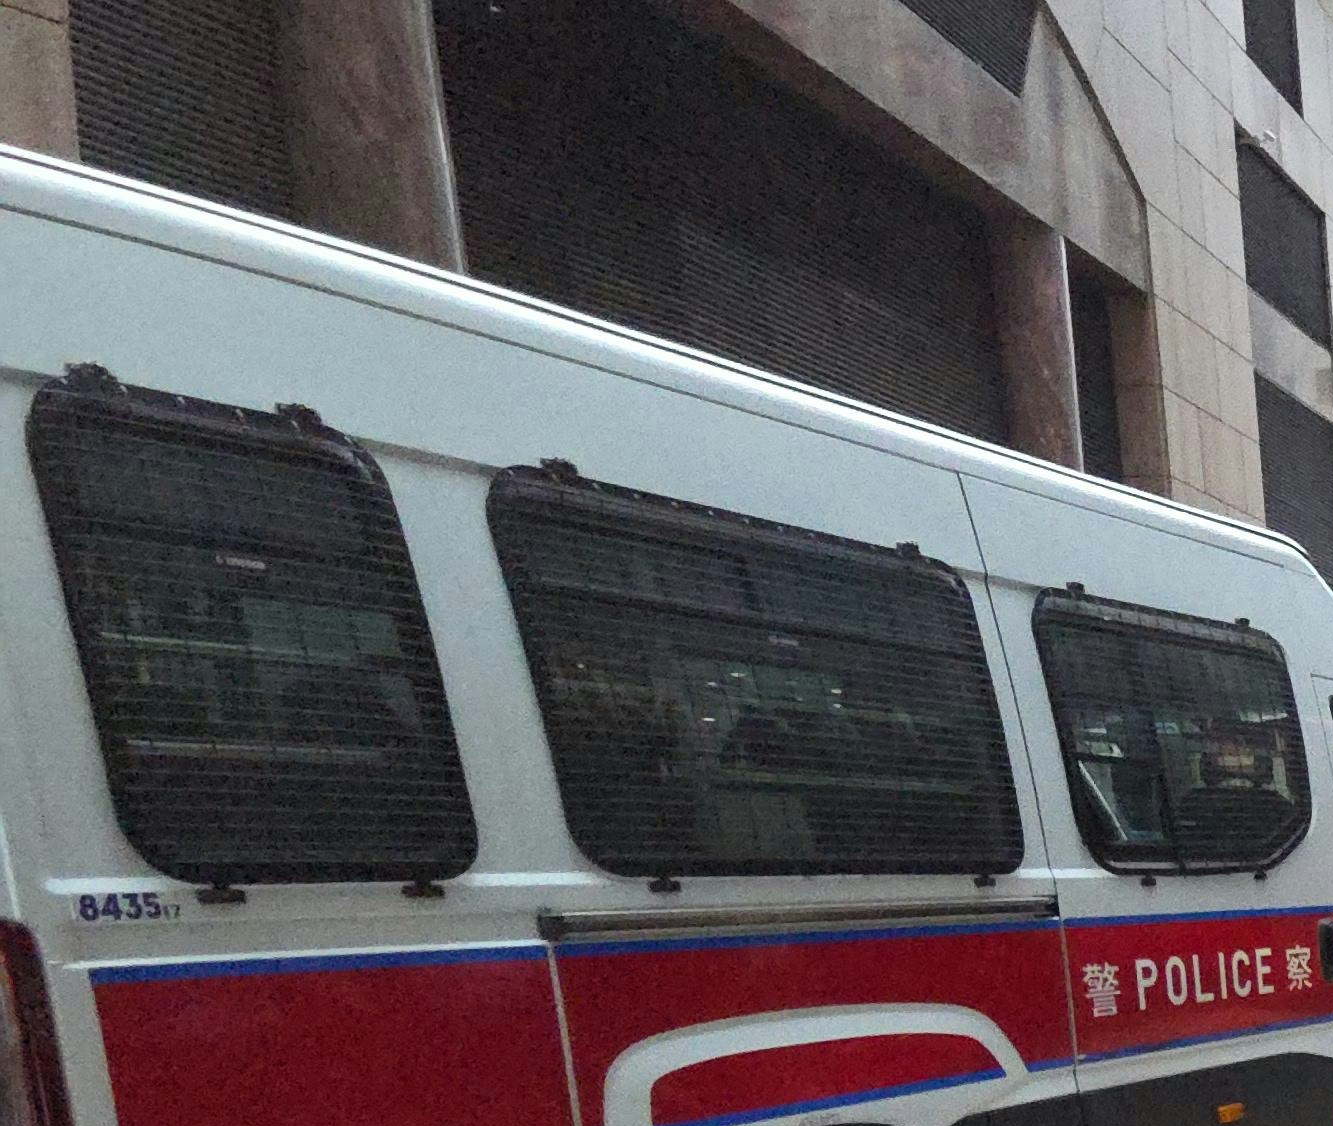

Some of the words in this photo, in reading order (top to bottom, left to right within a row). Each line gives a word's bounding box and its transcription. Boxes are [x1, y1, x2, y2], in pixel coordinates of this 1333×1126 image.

[80, 892, 161, 921] 8435
[1082, 961, 1121, 1017] 警
[1134, 947, 1275, 1011] POLICE
[1285, 944, 1313, 991] 察
